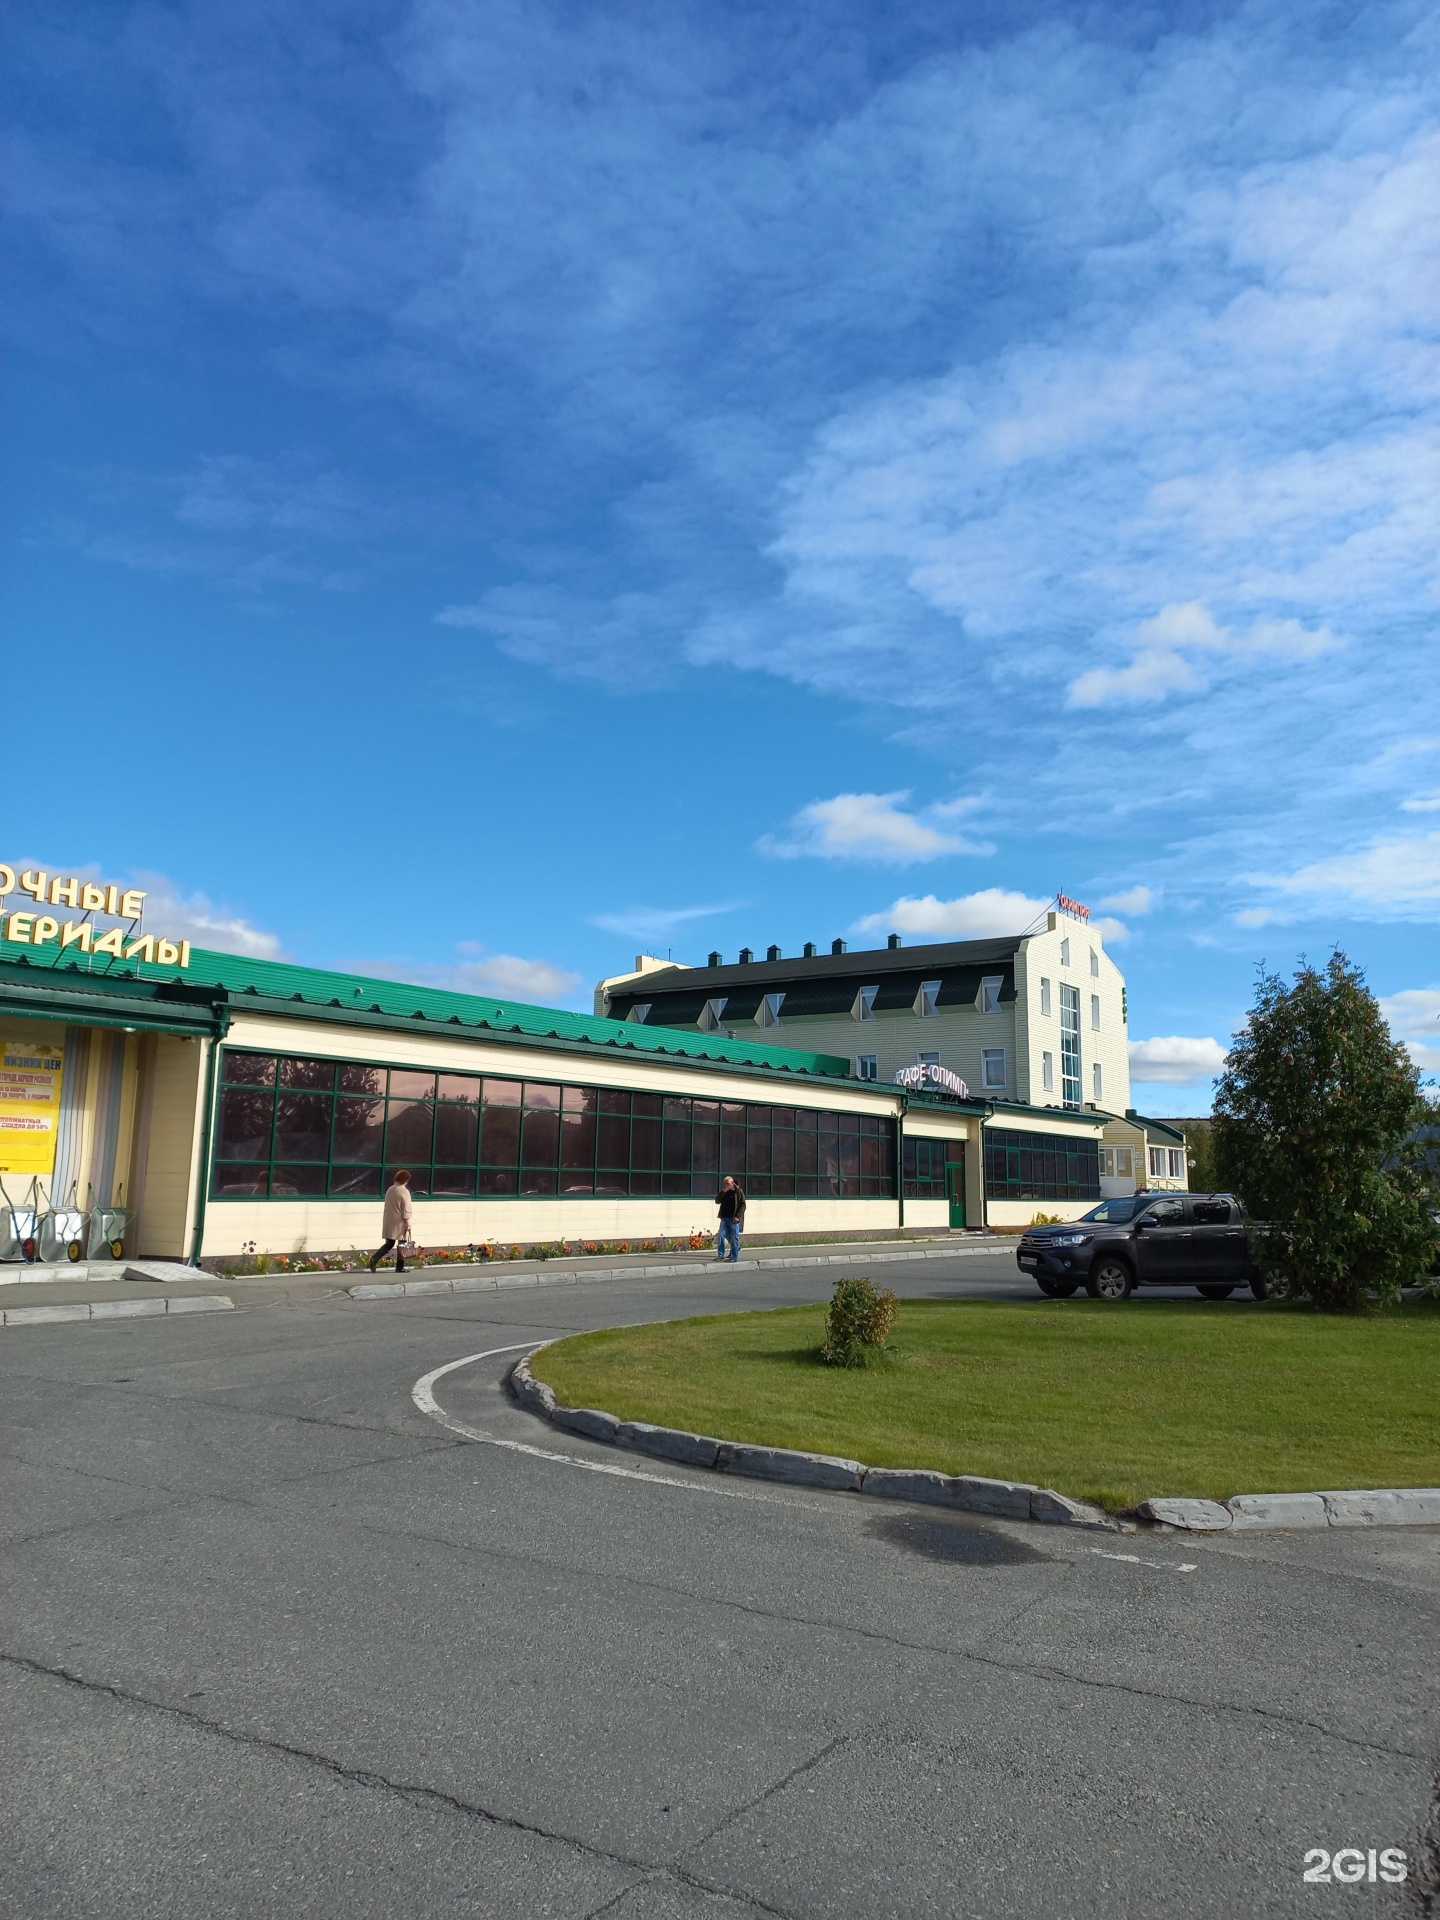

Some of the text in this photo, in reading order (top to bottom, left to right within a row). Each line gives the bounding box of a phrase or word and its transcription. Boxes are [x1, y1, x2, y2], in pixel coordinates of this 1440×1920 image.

[0, 863, 147, 919] ОЧНЫЕ
[0, 908, 191, 969] ЕРИАЛЫ
[896, 1063, 926, 1086] КАФЕ
